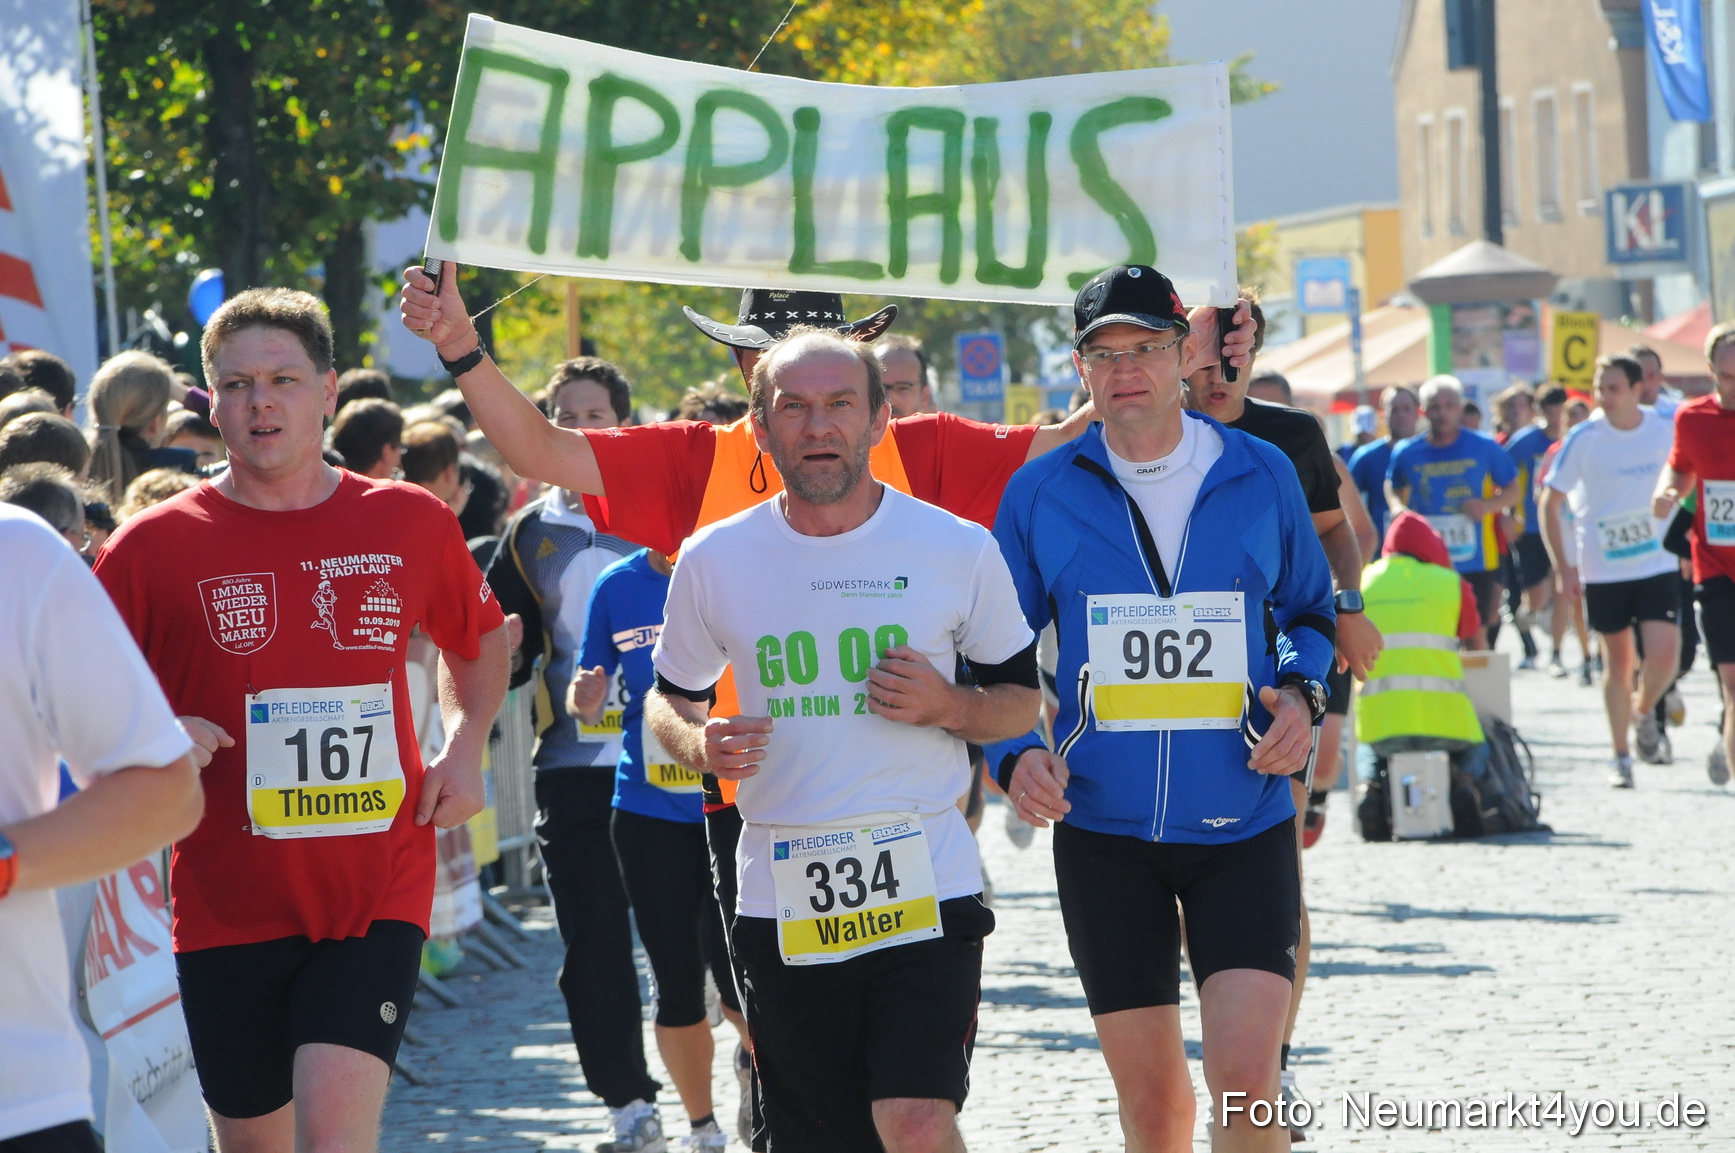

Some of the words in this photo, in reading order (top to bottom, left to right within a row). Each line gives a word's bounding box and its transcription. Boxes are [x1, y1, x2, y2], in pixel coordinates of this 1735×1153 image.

[440, 47, 1172, 288] APPLAUS
[1563, 334, 1587, 372] C
[1136, 466, 1162, 474] CRAFT
[1605, 520, 1652, 549] 2433
[300, 560, 319, 572] 11.
[320, 553, 404, 568] NEUMARKTER
[320, 564, 392, 580] STADTLAUF
[211, 583, 265, 600] IMMER
[810, 579, 891, 591] SÜDWESTPARK
[211, 595, 269, 612] WIEDER
[1110, 604, 1177, 618] PFLEIDERER
[1192, 607, 1232, 618] BOCK
[217, 607, 266, 630] NEU
[358, 616, 400, 628] 19.09.2010
[1110, 618, 1177, 626] AKTIENGESELLSCHAFT
[220, 627, 267, 643] MARKT
[756, 631, 819, 688] GO
[1122, 629, 1214, 680] 962
[271, 701, 345, 715] PFLEIDERER
[360, 699, 385, 712] BOCK
[801, 694, 841, 717] RUN
[271, 714, 345, 724] AKTIENGESELLSCHAFT
[284, 725, 374, 782] 167
[278, 788, 387, 818] Thomas
[790, 831, 856, 851] PFLEIDERER
[871, 822, 911, 840] BOCK
[791, 844, 857, 860] AKTIENGESELLSCHAFT
[805, 849, 900, 913] 334
[815, 908, 904, 946] Walter
